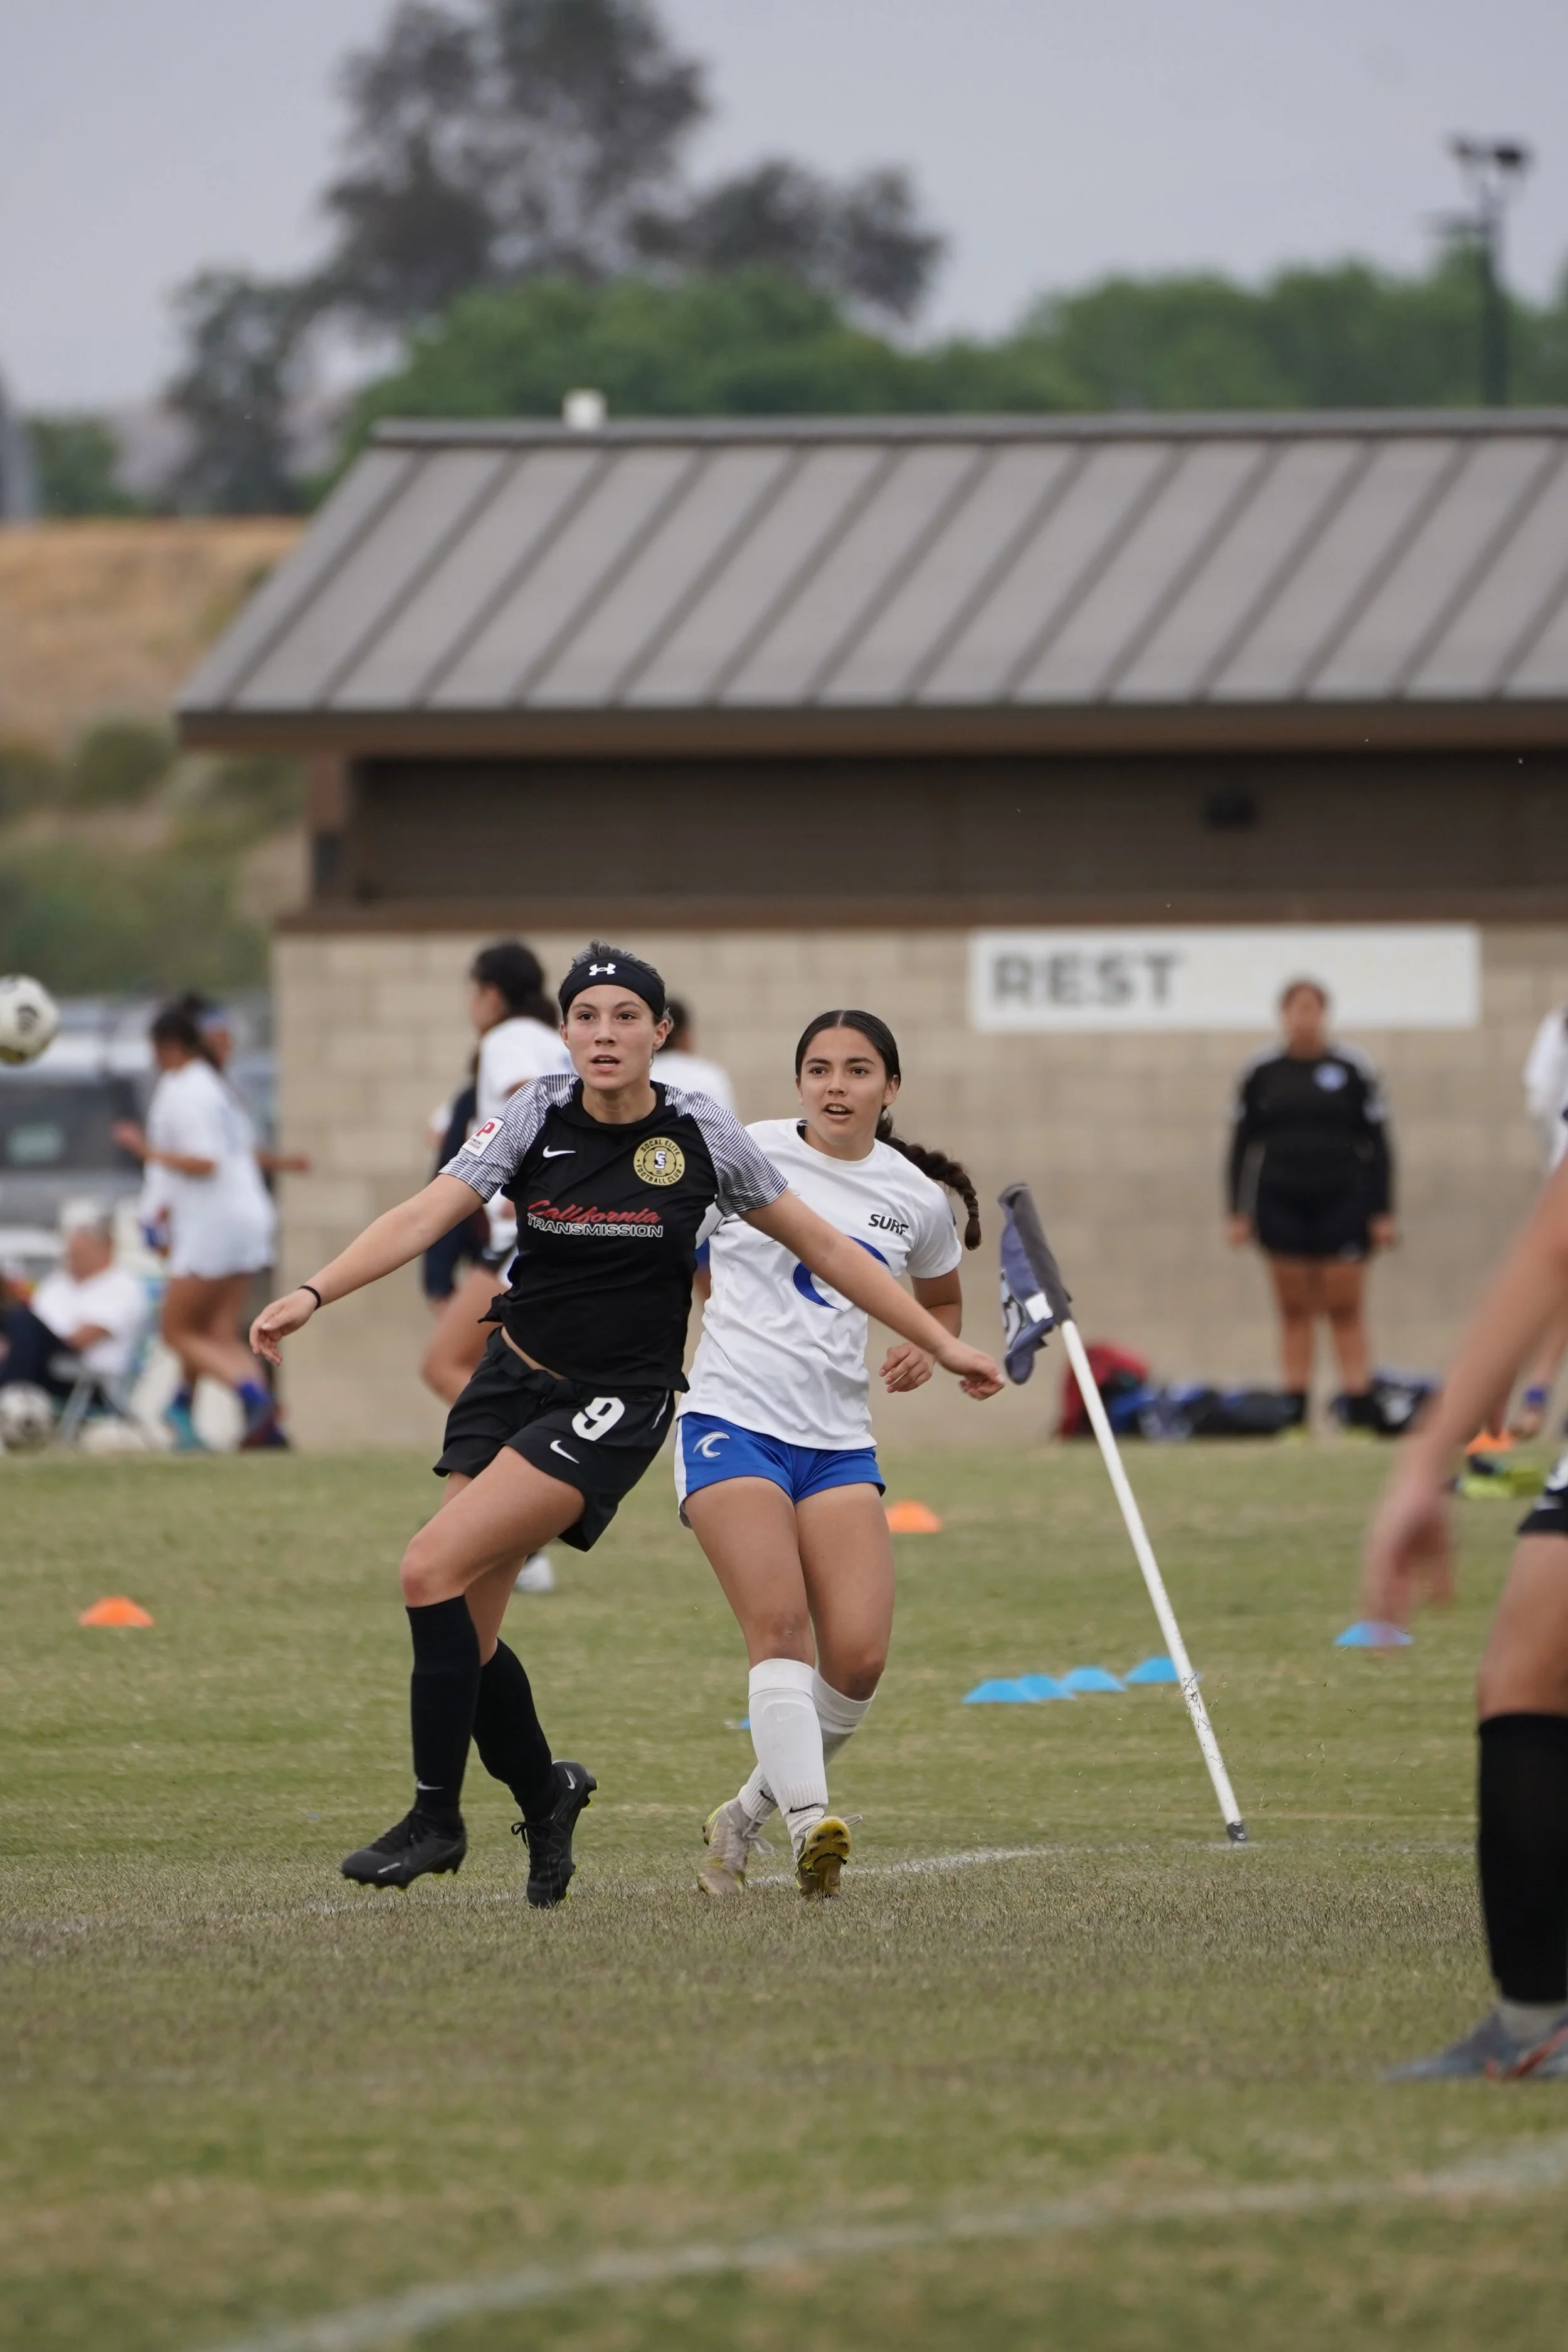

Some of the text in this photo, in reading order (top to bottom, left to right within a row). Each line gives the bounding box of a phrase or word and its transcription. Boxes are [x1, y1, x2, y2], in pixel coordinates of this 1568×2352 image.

[992, 951, 1181, 1008] REST
[640, 1138, 681, 1155] SOCAL ELITE
[636, 1164, 682, 1184] FOOTBALL CLUB
[527, 1199, 661, 1224] California
[527, 1212, 664, 1237] TRANSMISSION
[868, 1214, 909, 1236] SURF
[571, 1397, 625, 1441] 9
